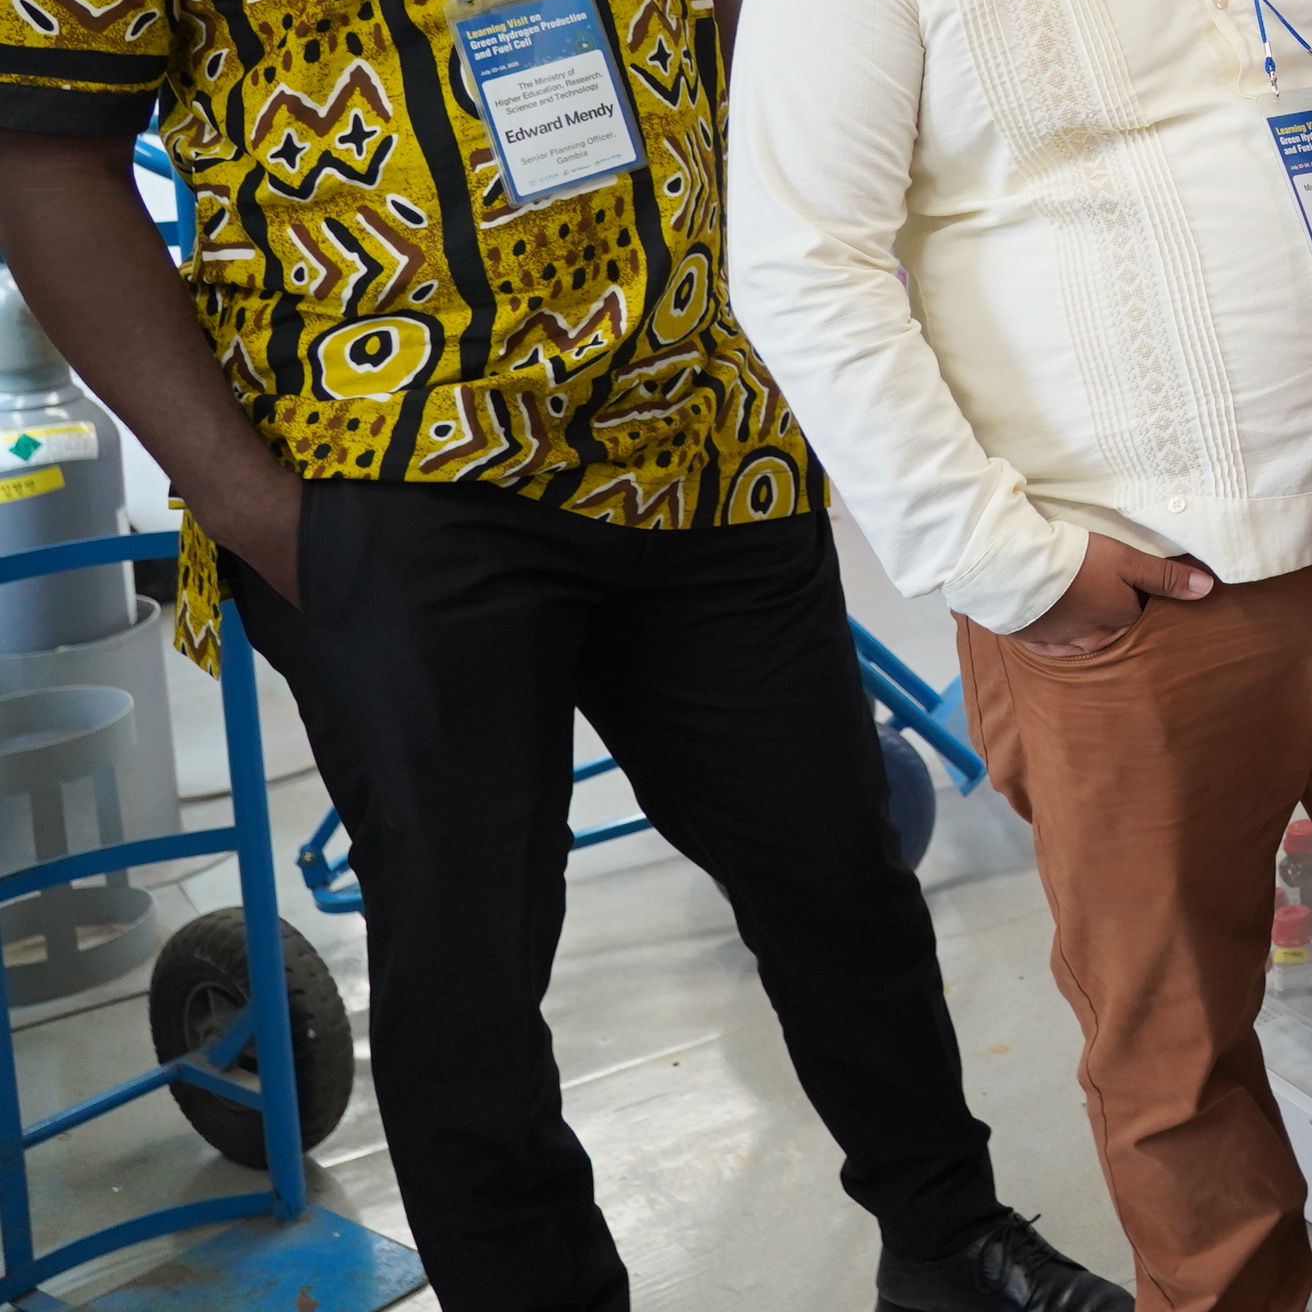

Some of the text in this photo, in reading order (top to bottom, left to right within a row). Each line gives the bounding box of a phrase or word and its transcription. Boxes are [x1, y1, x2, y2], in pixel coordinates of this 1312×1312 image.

[465, 13, 542, 40] Learning Visit on
[470, 12, 588, 50] Green Hydrogen Production
[474, 37, 533, 61] and Fuel Cell
[518, 68, 576, 90] The Ministry of
[494, 94, 522, 108] Higher
[522, 83, 564, 100] Education,
[505, 83, 599, 115] Science and Technology
[505, 102, 614, 144] Edward Mendy
[1275, 124, 1307, 136] Learning
[520, 132, 617, 166] Senior Planning Officer,
[1280, 135, 1301, 145] Green
[1283, 146, 1299, 155] and
[1297, 142, 1312, 153] Fuel
[556, 150, 589, 165] Gambia
